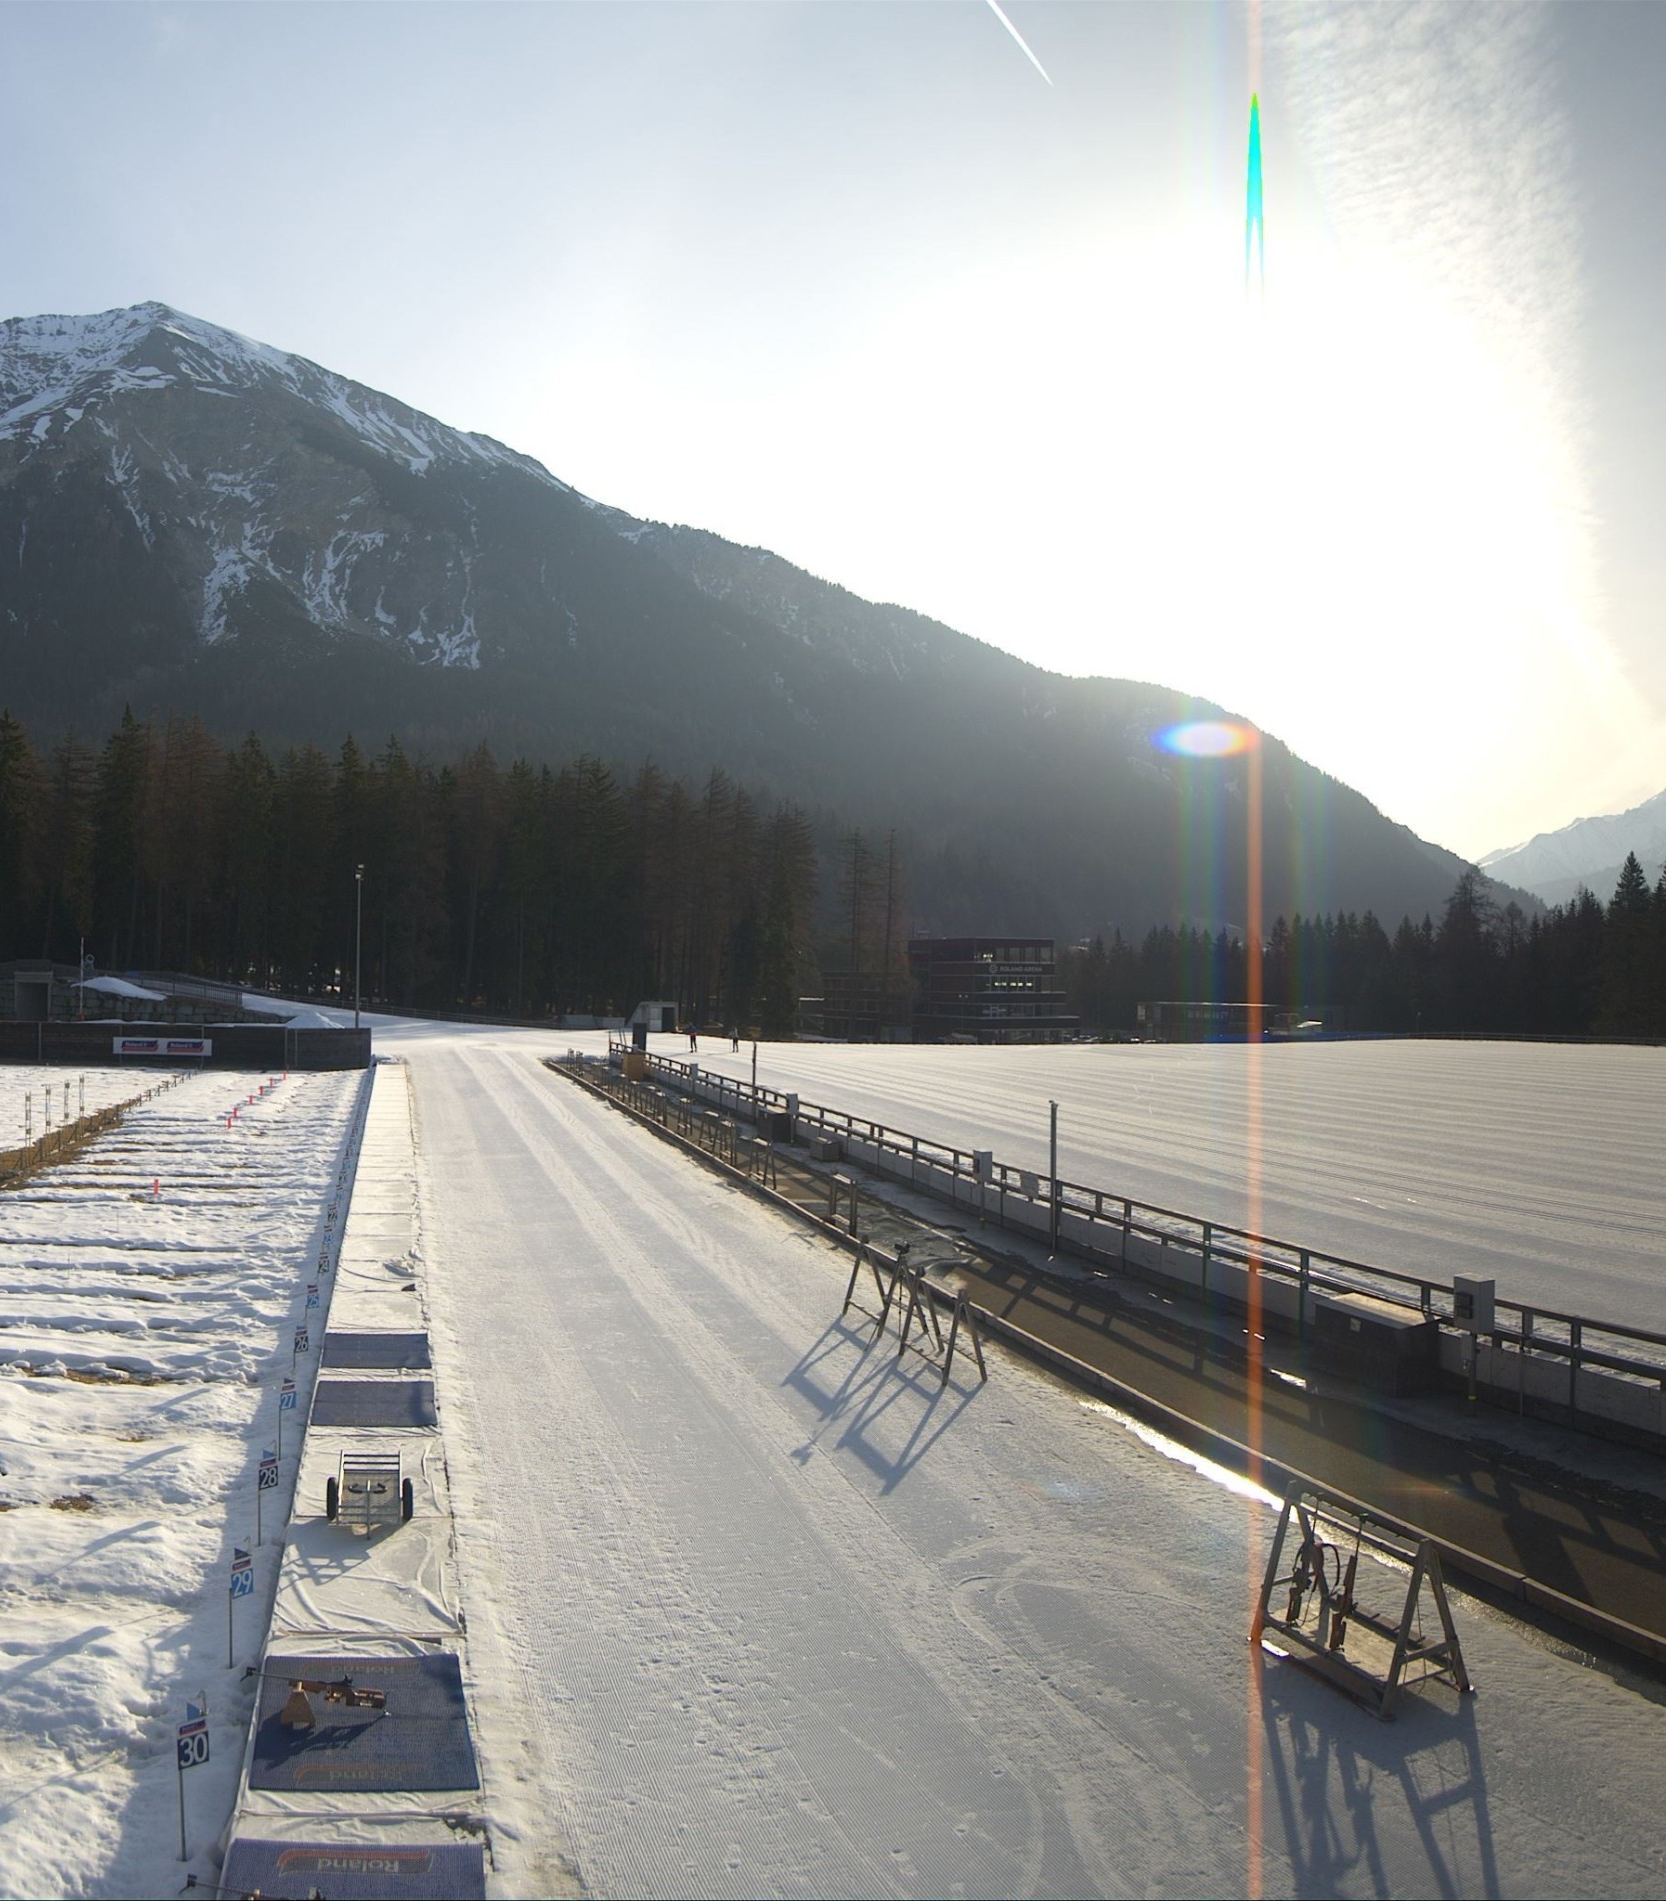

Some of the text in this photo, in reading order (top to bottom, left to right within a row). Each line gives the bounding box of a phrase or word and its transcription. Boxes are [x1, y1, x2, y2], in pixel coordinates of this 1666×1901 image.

[296, 1337, 308, 1351] 26
[281, 1393, 294, 1408] 27
[260, 1468, 278, 1488] 28
[233, 1570, 253, 1597] 29
[179, 1733, 208, 1767] 30
[317, 1857, 400, 1873] Roland
